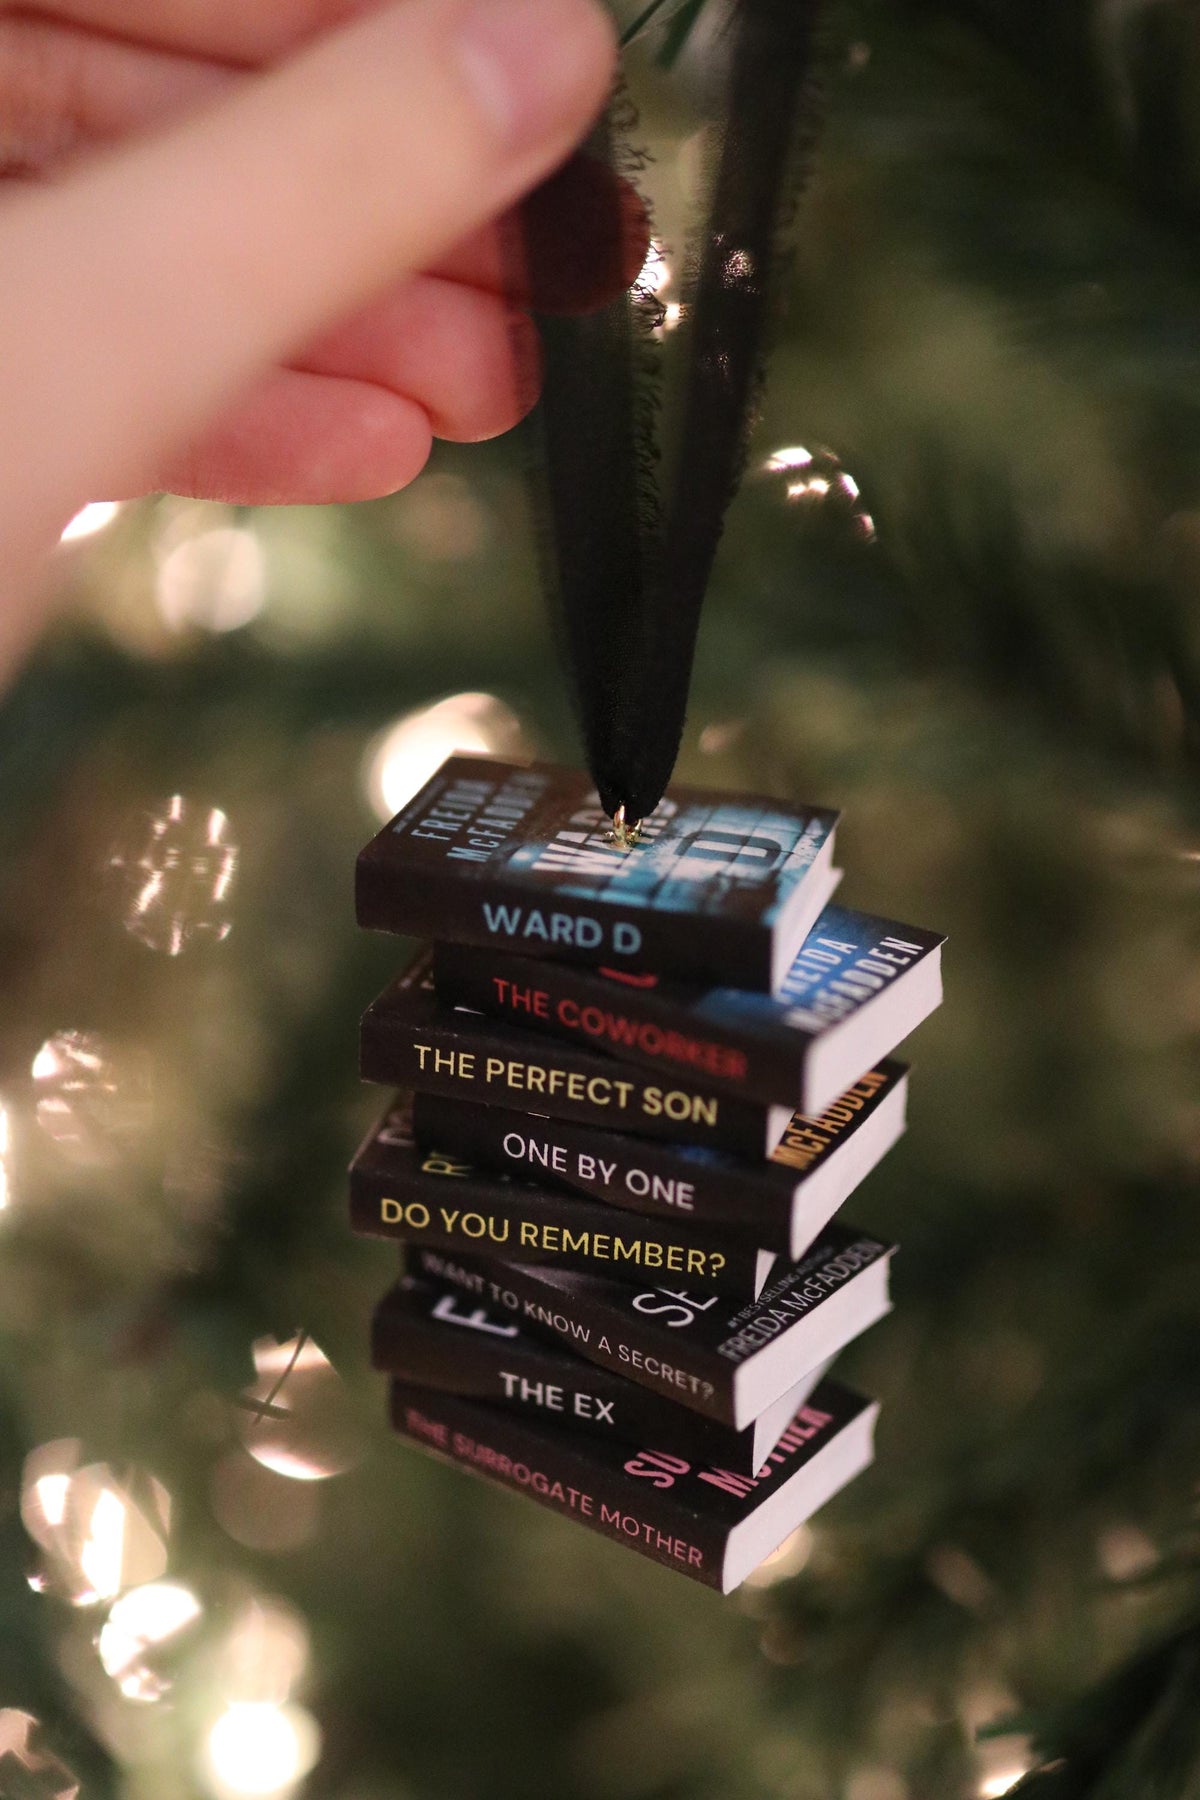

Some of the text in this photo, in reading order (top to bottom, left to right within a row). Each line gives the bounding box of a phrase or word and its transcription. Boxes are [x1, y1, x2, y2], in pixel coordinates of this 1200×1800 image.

[446, 772, 549, 862] MCFA
[482, 902, 643, 955] WARD D
[774, 937, 859, 1004] EIDA
[785, 937, 924, 1033] FADDEN
[493, 976, 748, 1078] THE COWORKER
[414, 1044, 719, 1126] THE PERFECT SON
[503, 1132, 695, 1211] ONE BY ONE
[381, 1198, 726, 1278] DO YOU REMEMBER?
[421, 1252, 485, 1294] WANT
[489, 1283, 520, 1311] TO
[523, 1301, 591, 1343] KNOW
[598, 1336, 612, 1355] A
[618, 1344, 716, 1400] SECRET?
[717, 1308, 796, 1363] FREIDA
[499, 1371, 616, 1425] THE EX
[452, 1431, 594, 1516] SURROGATE
[600, 1504, 704, 1569] MOTHER
